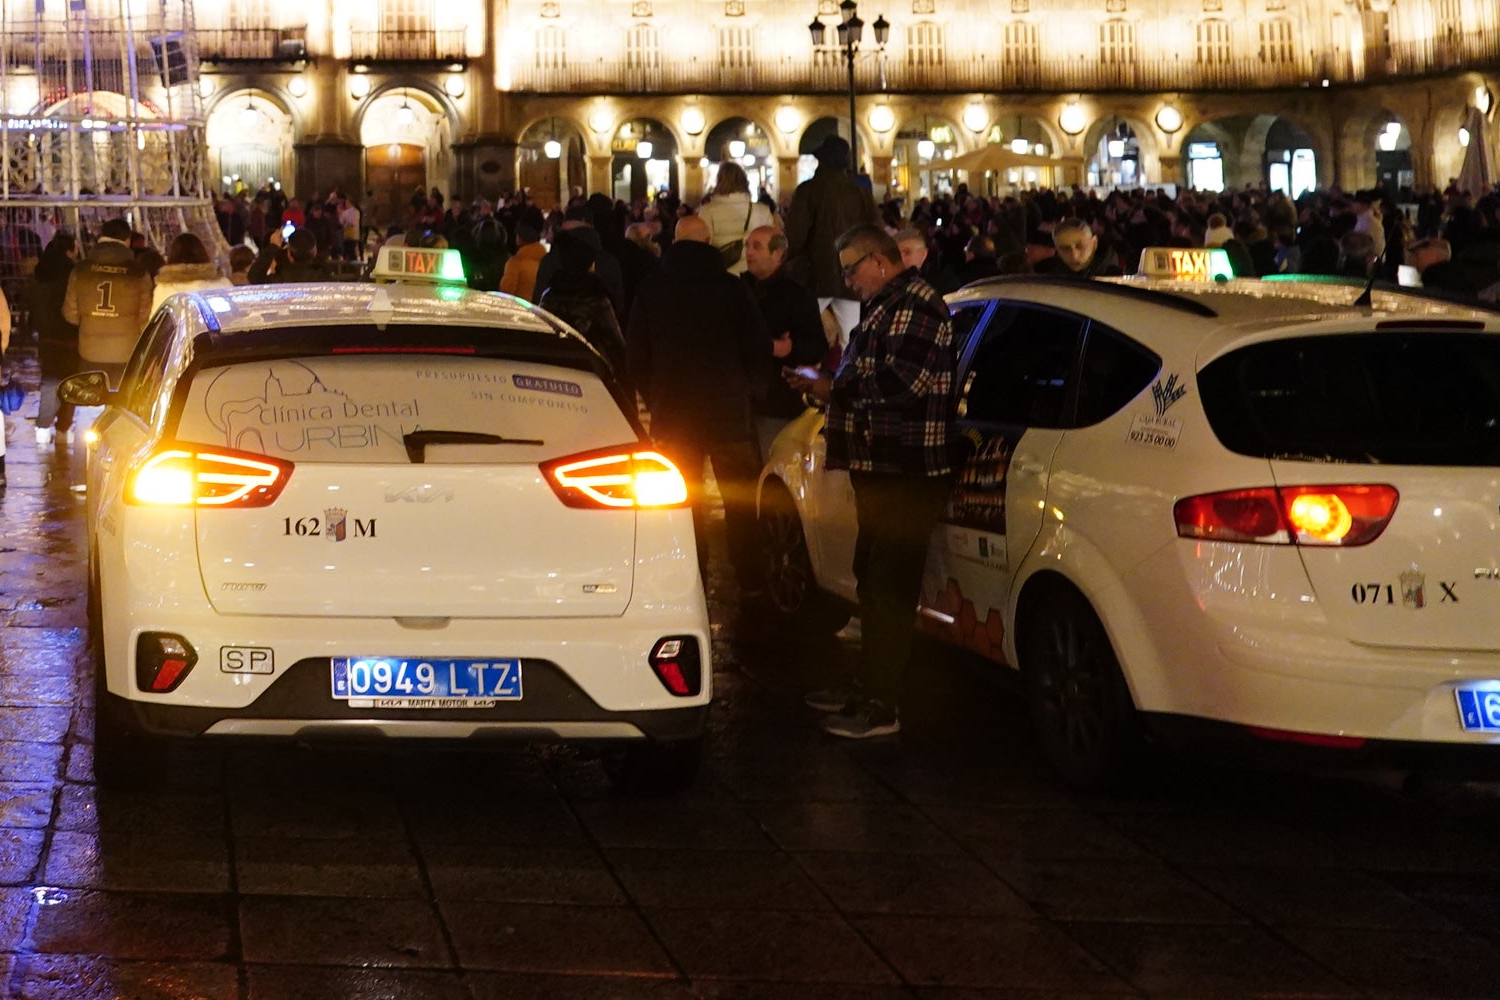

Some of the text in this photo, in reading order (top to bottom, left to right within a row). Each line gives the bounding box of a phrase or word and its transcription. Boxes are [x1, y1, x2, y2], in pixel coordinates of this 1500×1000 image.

[1171, 251, 1211, 274] TAXI
[96, 280, 116, 313] 1
[415, 370, 579, 395] PRESUPUESTO GRATUITO
[343, 399, 420, 419] Dental
[471, 390, 588, 414] SIN COMPROMISO
[283, 517, 377, 538] 162 M
[1351, 581, 1460, 604] 071 X
[226, 650, 268, 671] SP
[351, 661, 435, 695] 0949
[449, 662, 514, 696] LTZ
[408, 699, 436, 708] MARTA
[439, 699, 468, 708] MOTOR
